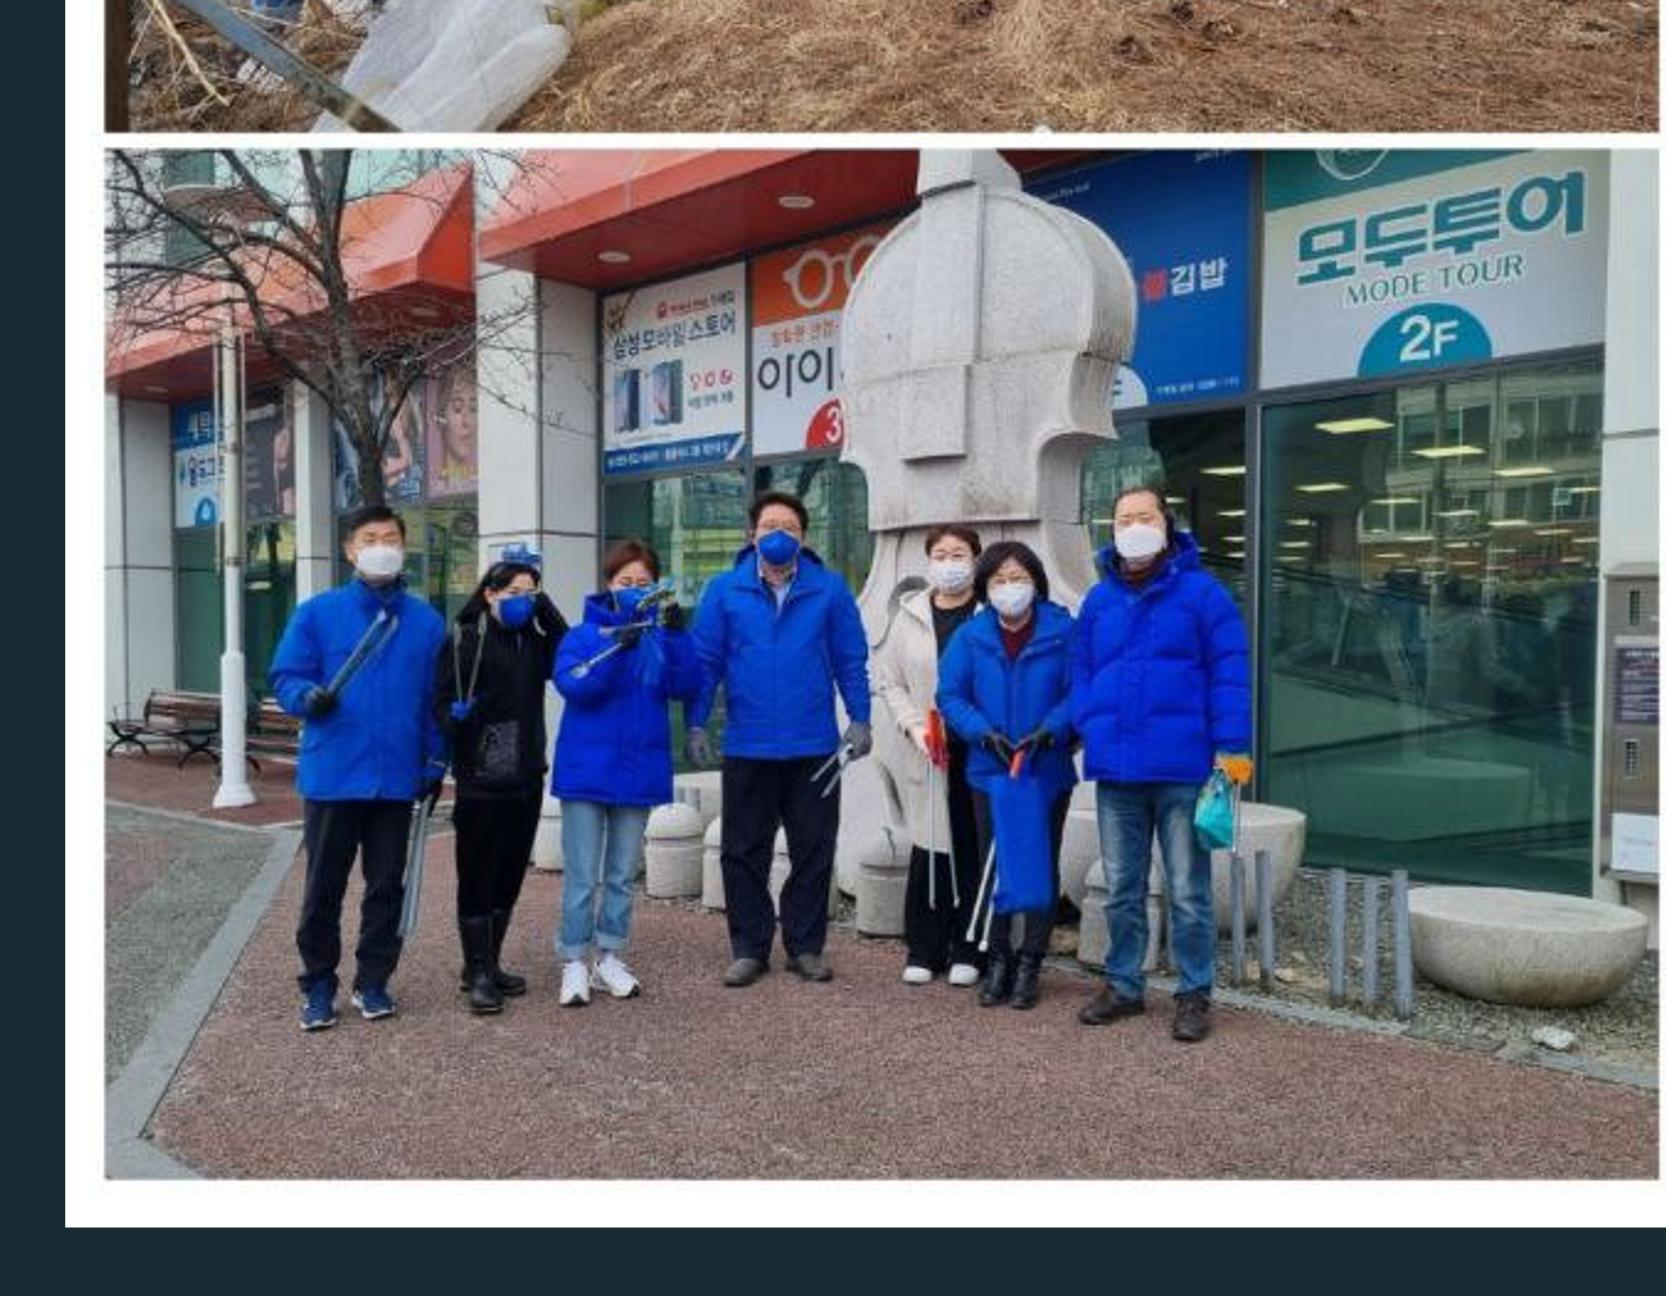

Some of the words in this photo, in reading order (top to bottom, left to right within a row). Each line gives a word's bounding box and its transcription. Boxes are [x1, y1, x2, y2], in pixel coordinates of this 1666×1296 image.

[1297, 170, 1586, 286] 모두투어
[1171, 257, 1227, 296] 김밥
[1346, 274, 1429, 306] MODE
[1438, 254, 1524, 289] TOUR
[1399, 315, 1459, 362] 2F
[757, 346, 844, 398] 아이
